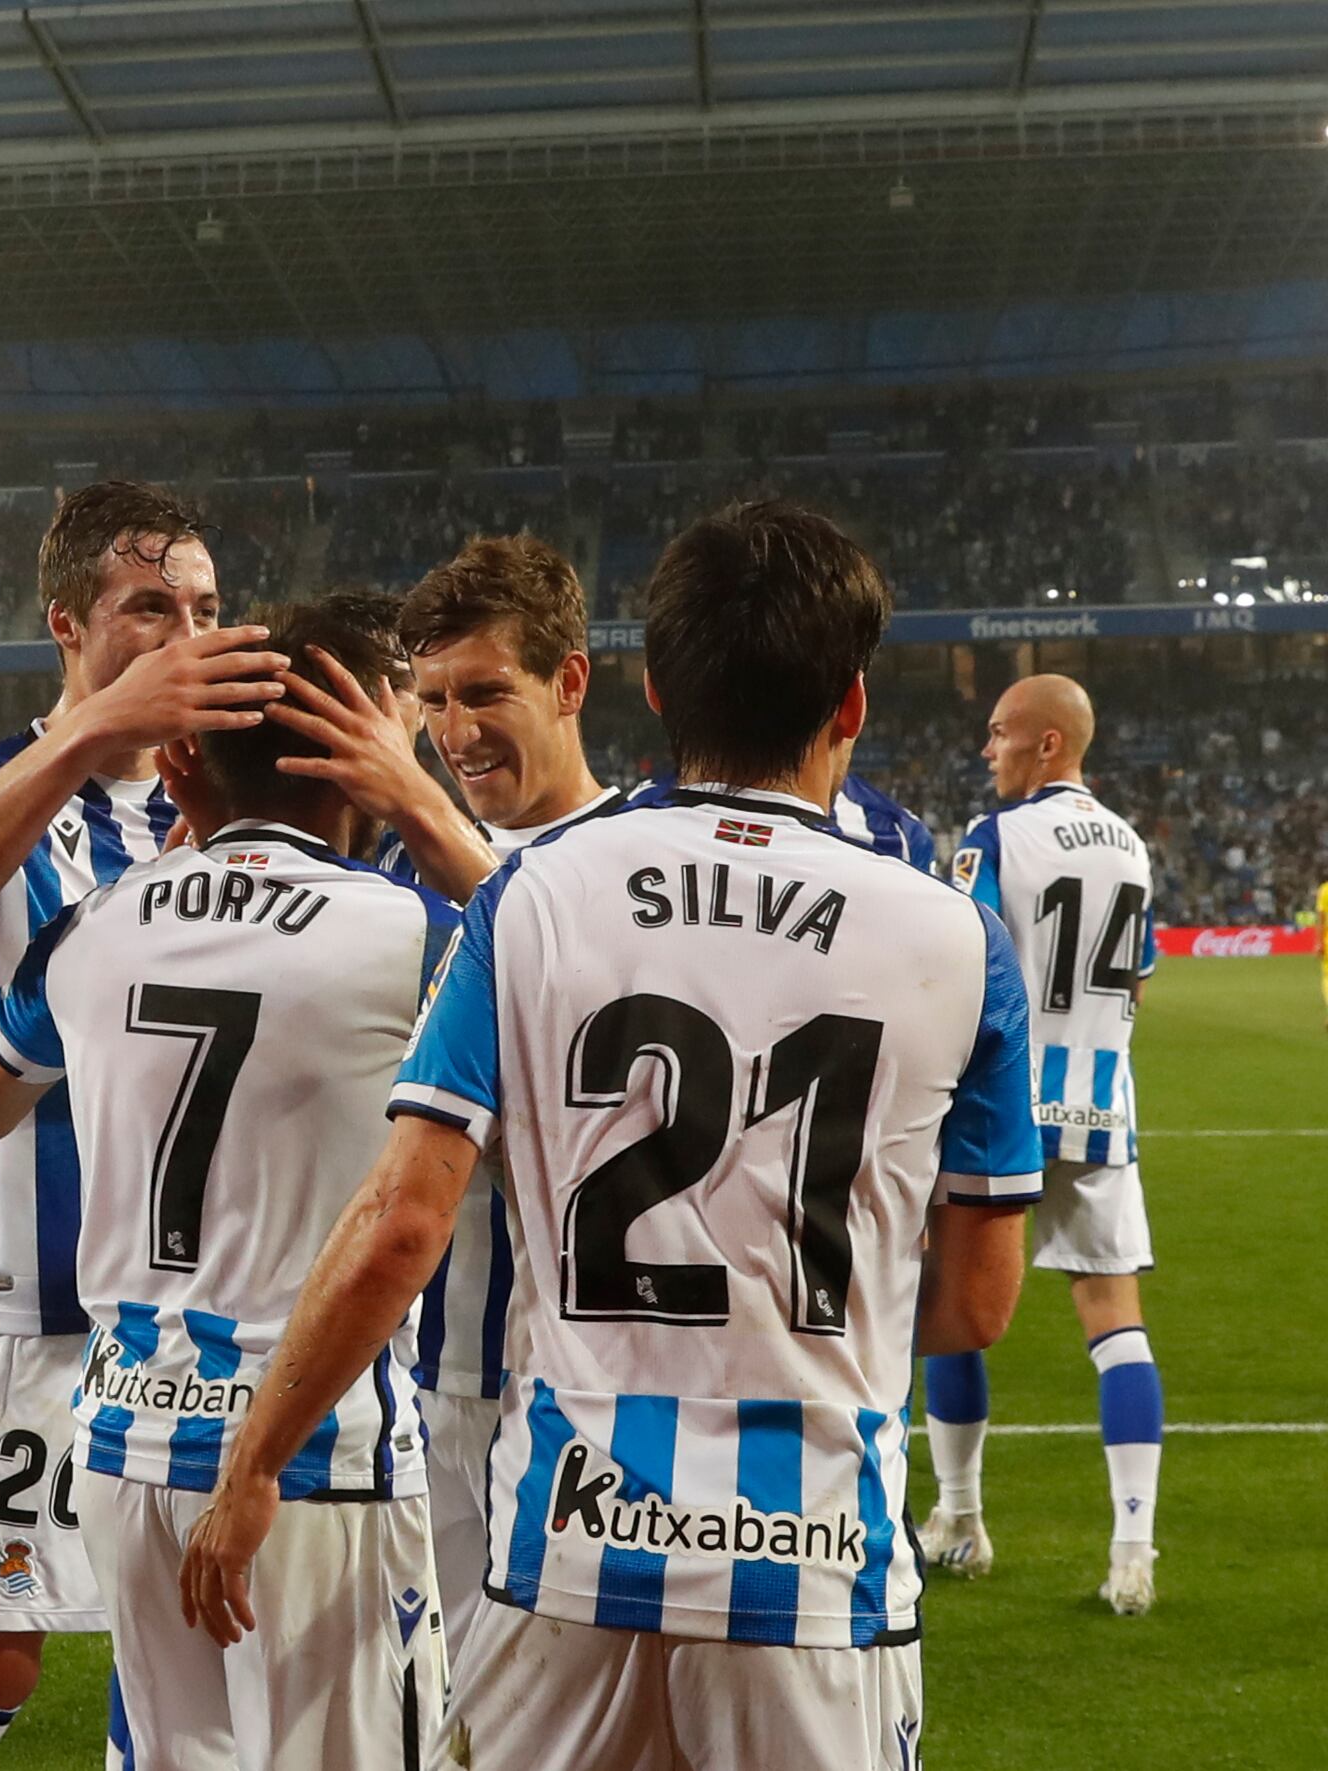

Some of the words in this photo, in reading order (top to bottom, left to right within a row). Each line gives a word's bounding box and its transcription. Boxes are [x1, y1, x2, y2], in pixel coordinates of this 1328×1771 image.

[971, 613, 1099, 637] finetwork
[1194, 609, 1256, 631] IMQ
[1053, 821, 1136, 857] GURIDI
[139, 871, 330, 936] PORTU
[627, 863, 846, 955] SILVA
[1035, 876, 1147, 1021] 14
[125, 983, 262, 1274] 7
[560, 993, 884, 1337] 21
[84, 1327, 255, 1413] Kutxaban
[552, 1444, 861, 1563] Kutxabank
